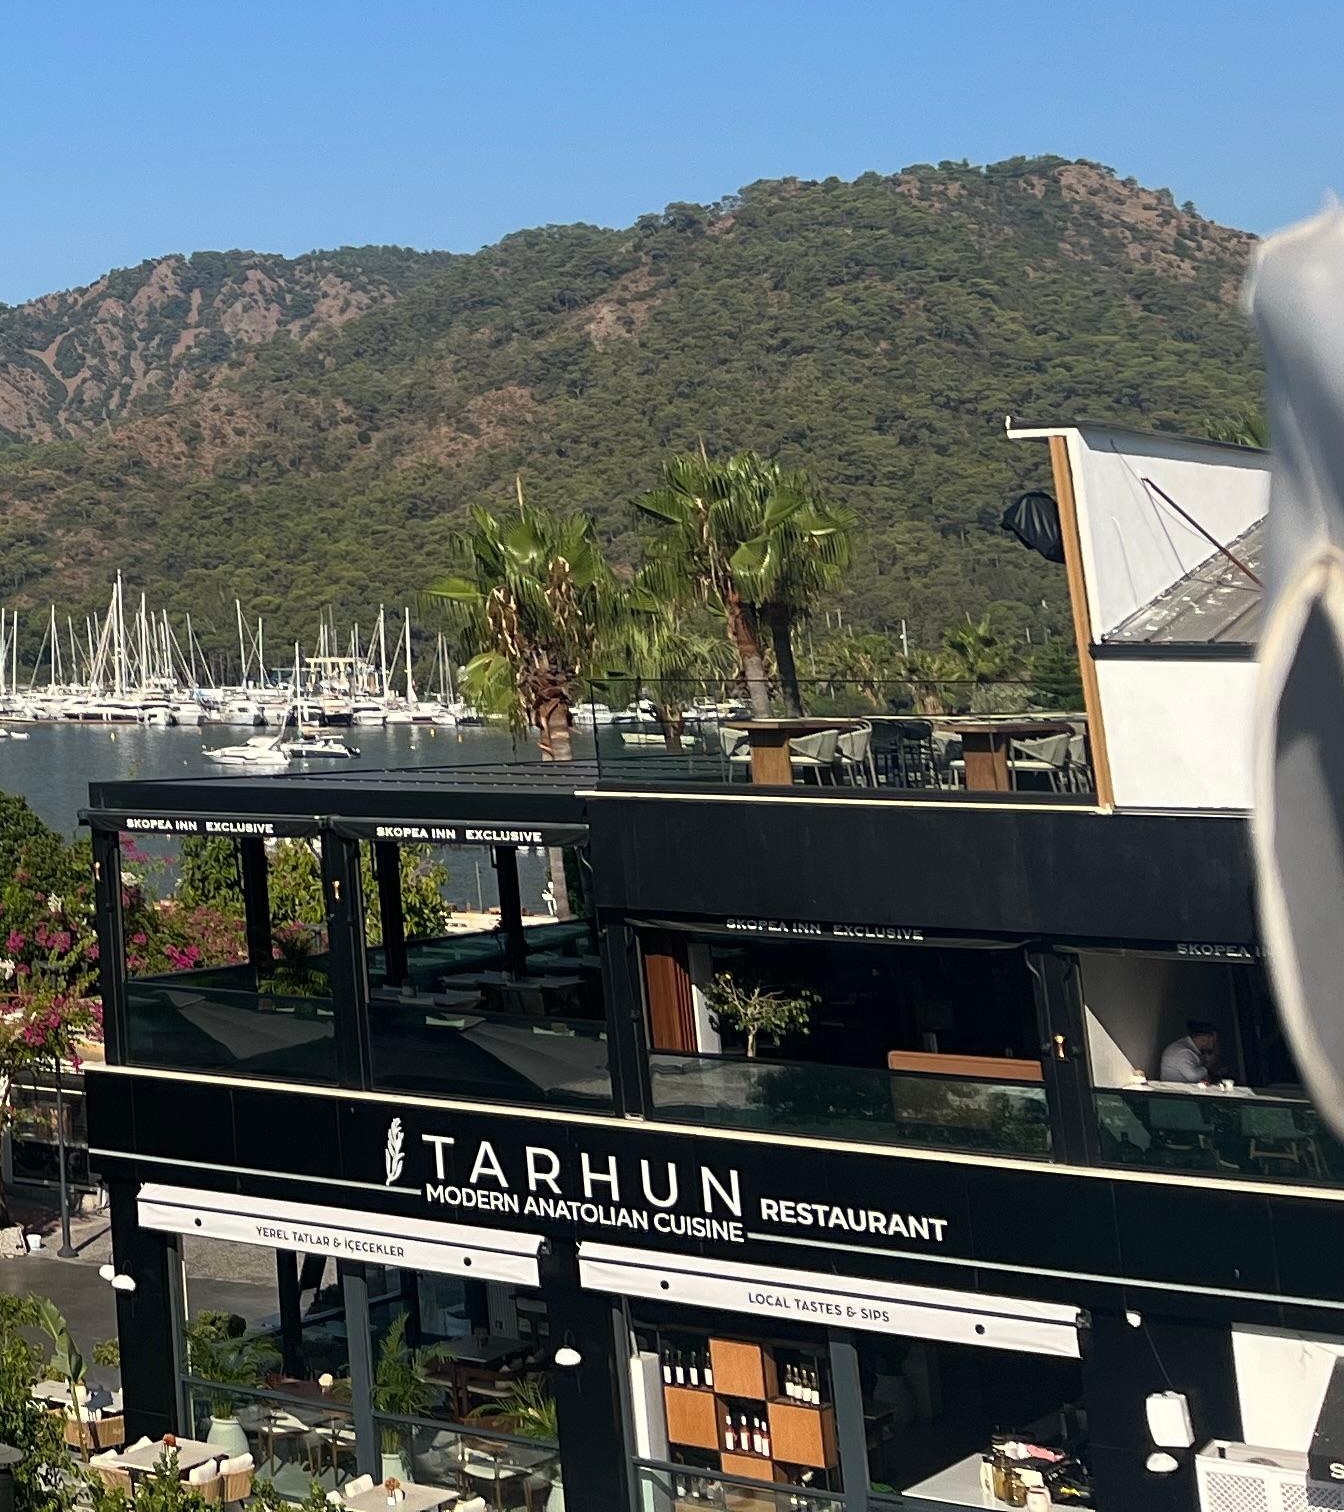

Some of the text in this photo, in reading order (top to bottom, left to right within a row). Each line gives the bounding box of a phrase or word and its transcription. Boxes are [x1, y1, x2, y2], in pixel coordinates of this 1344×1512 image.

[126, 818, 274, 834] SKOPEA INN EXCLUSIVE
[375, 826, 542, 842] SKOPEA INN EXCLUSIVE
[726, 918, 924, 941] SKOPEA INN EXCLUSIVE
[1176, 943, 1251, 958] SKOPEA
[421, 1133, 742, 1217] TARHUN
[425, 1183, 745, 1243] MODERN ANATOLIAN CUISINE
[760, 1197, 948, 1242] RESTAURANT
[256, 1226, 405, 1257] YEREL TATLAR & İÇECEKLER
[748, 1292, 890, 1322] LOCAL TASTES & SIPS
